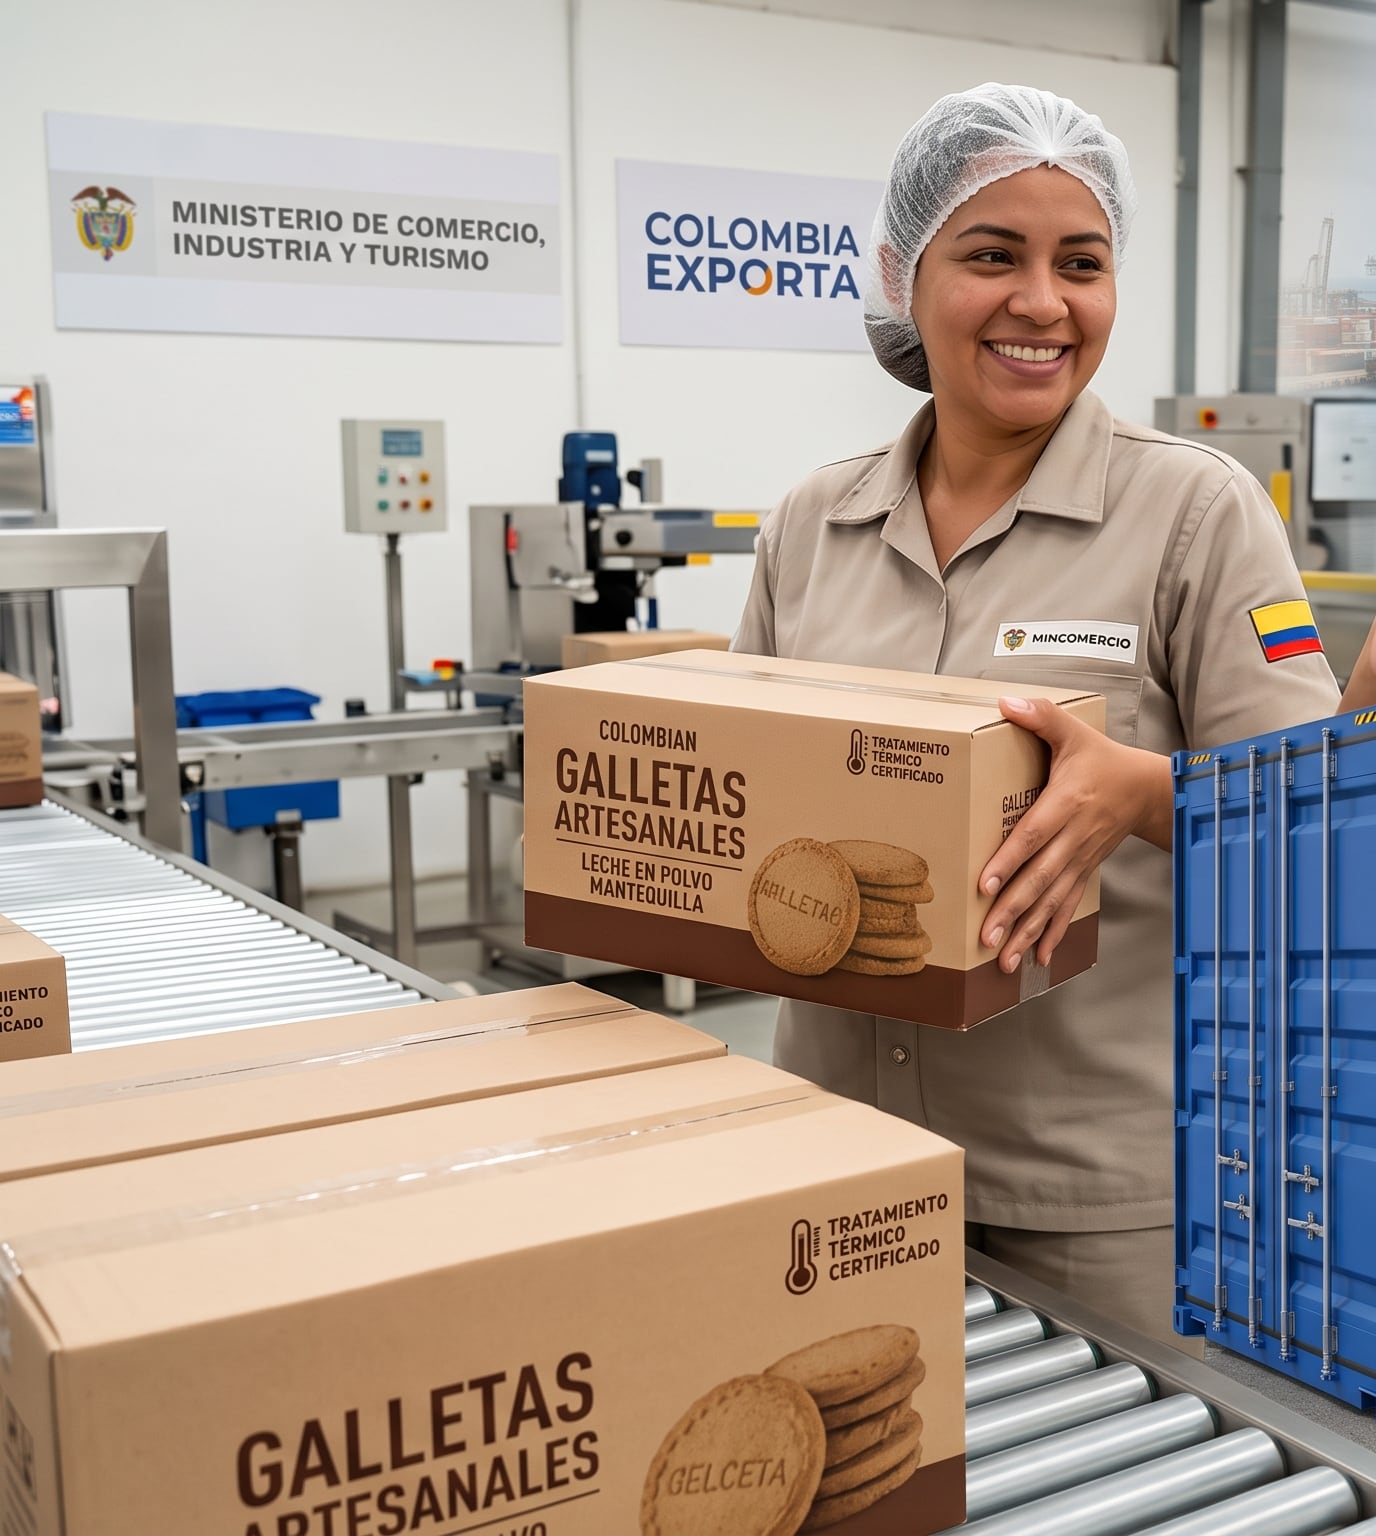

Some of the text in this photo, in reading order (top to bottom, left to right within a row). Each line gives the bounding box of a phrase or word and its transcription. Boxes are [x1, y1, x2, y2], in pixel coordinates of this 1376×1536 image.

[171, 200, 546, 249] MINISTERIO DE COMERCIO,
[645, 211, 861, 258] COLOMBIA
[172, 233, 490, 272] INDUSTRIA Y TURISMO
[647, 253, 861, 300] EXPORTA
[1032, 632, 1131, 650] MINCOMERCIO
[599, 719, 697, 753] COLOMBIAN
[872, 736, 951, 756] TRATAMIENTO
[871, 765, 944, 785] CERTIFICADO
[872, 746, 922, 767] TÉRMICO
[555, 748, 747, 820] GALLETAS
[554, 800, 746, 860] ARTESANALES
[582, 853, 713, 893] LECHE EN POLVO
[590, 876, 704, 914] MANTEQUILLA
[0, 986, 49, 1003] IENTO
[827, 1193, 948, 1236] TRATAMIENTO
[828, 1225, 906, 1259] TÉRMICO
[829, 1238, 940, 1281] CERTIFICADO
[236, 1351, 594, 1508] GALLETAS
[245, 1430, 600, 1536] RTESANALES
